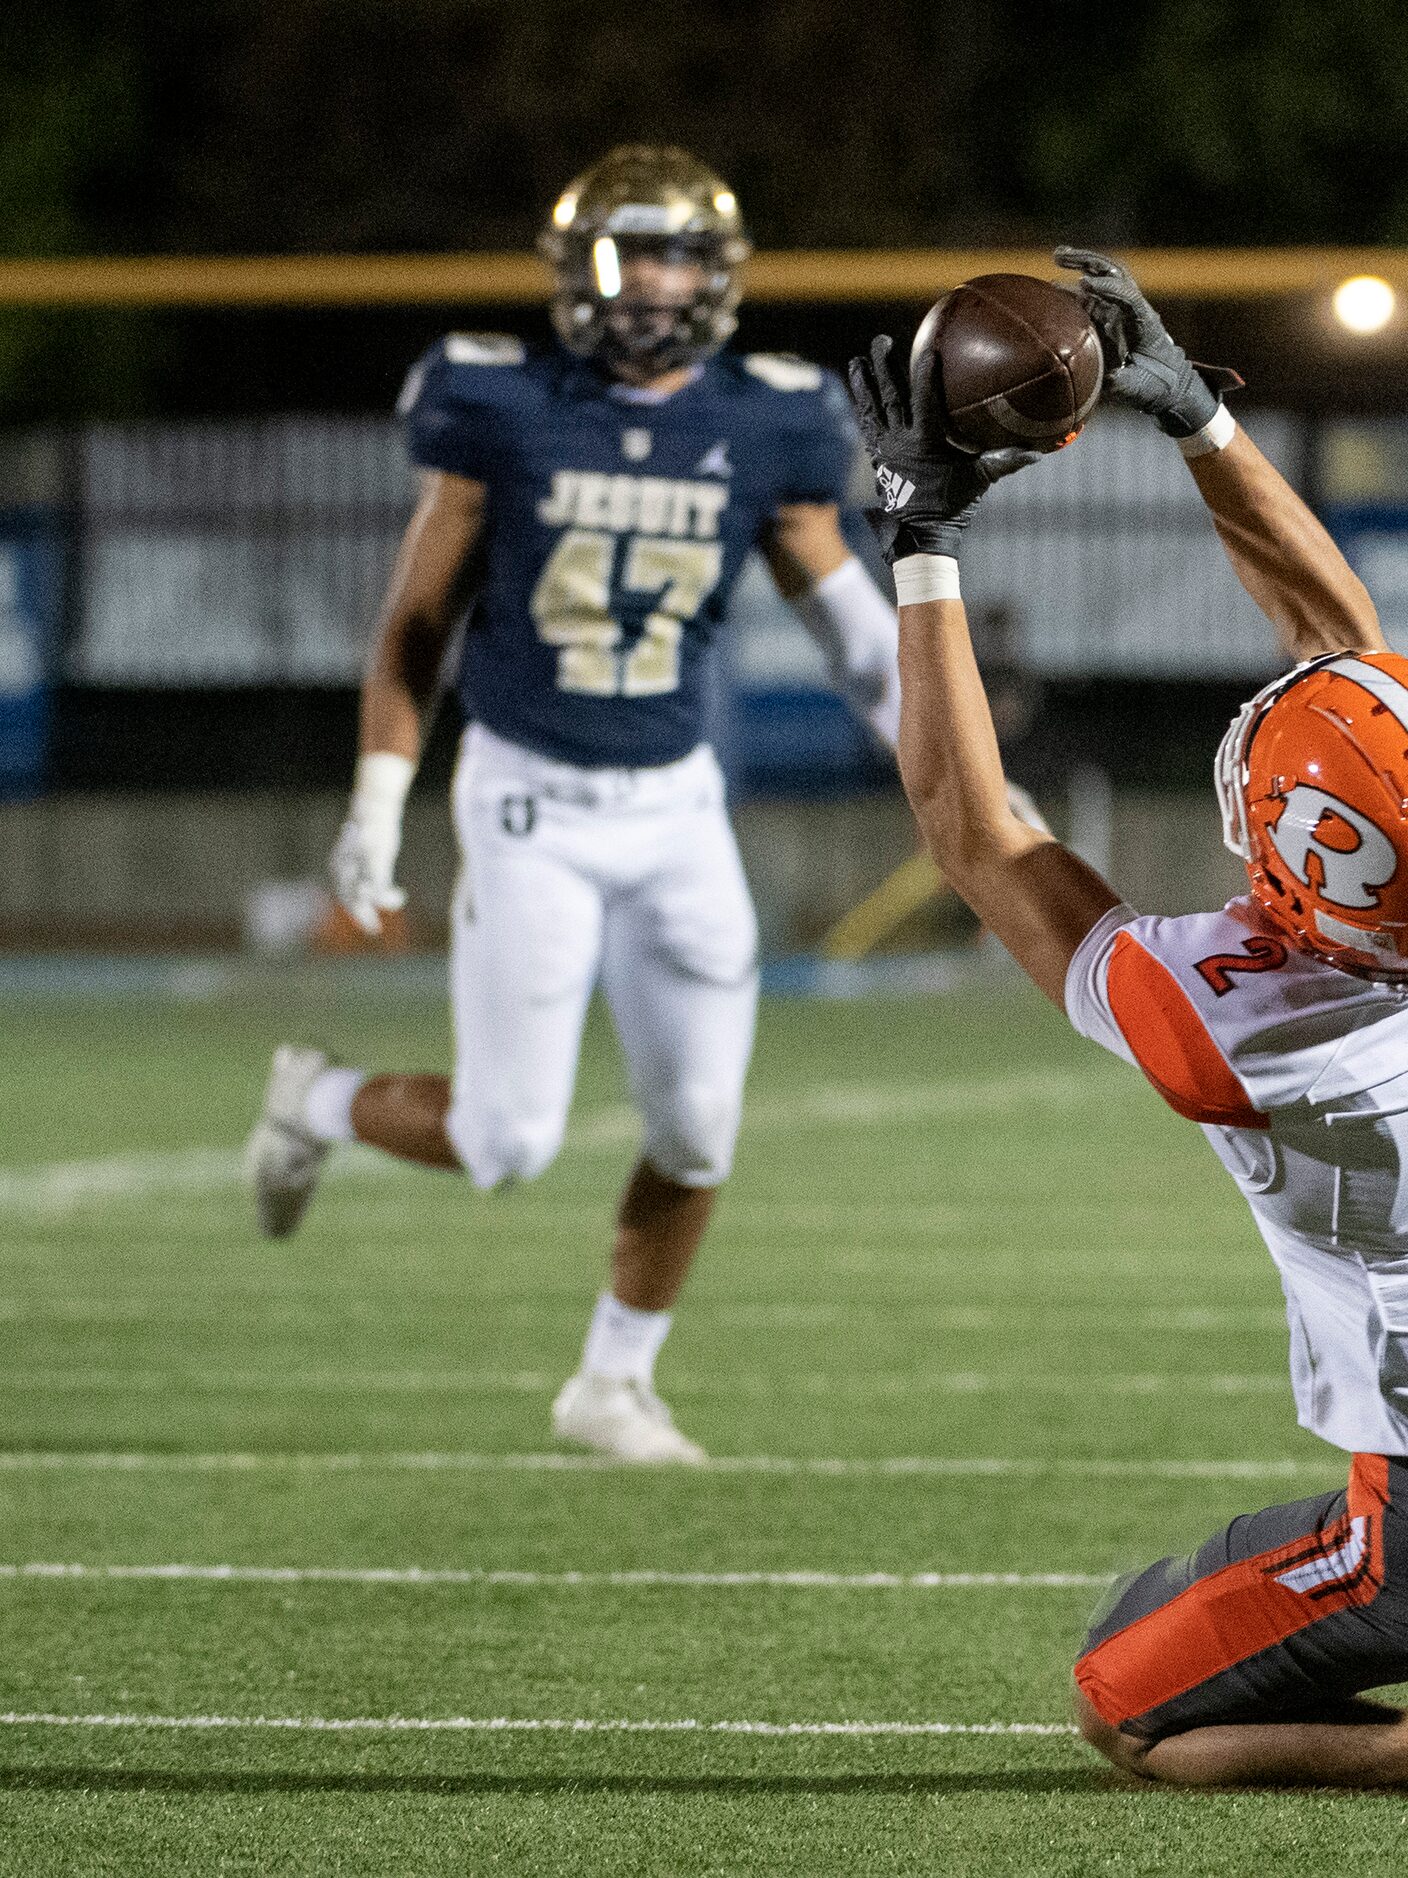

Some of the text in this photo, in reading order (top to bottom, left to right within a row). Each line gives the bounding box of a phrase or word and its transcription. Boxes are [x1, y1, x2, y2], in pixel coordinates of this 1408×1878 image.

[531, 530, 723, 695] 47
[1265, 783, 1397, 911] R
[1193, 936, 1288, 998] 2
